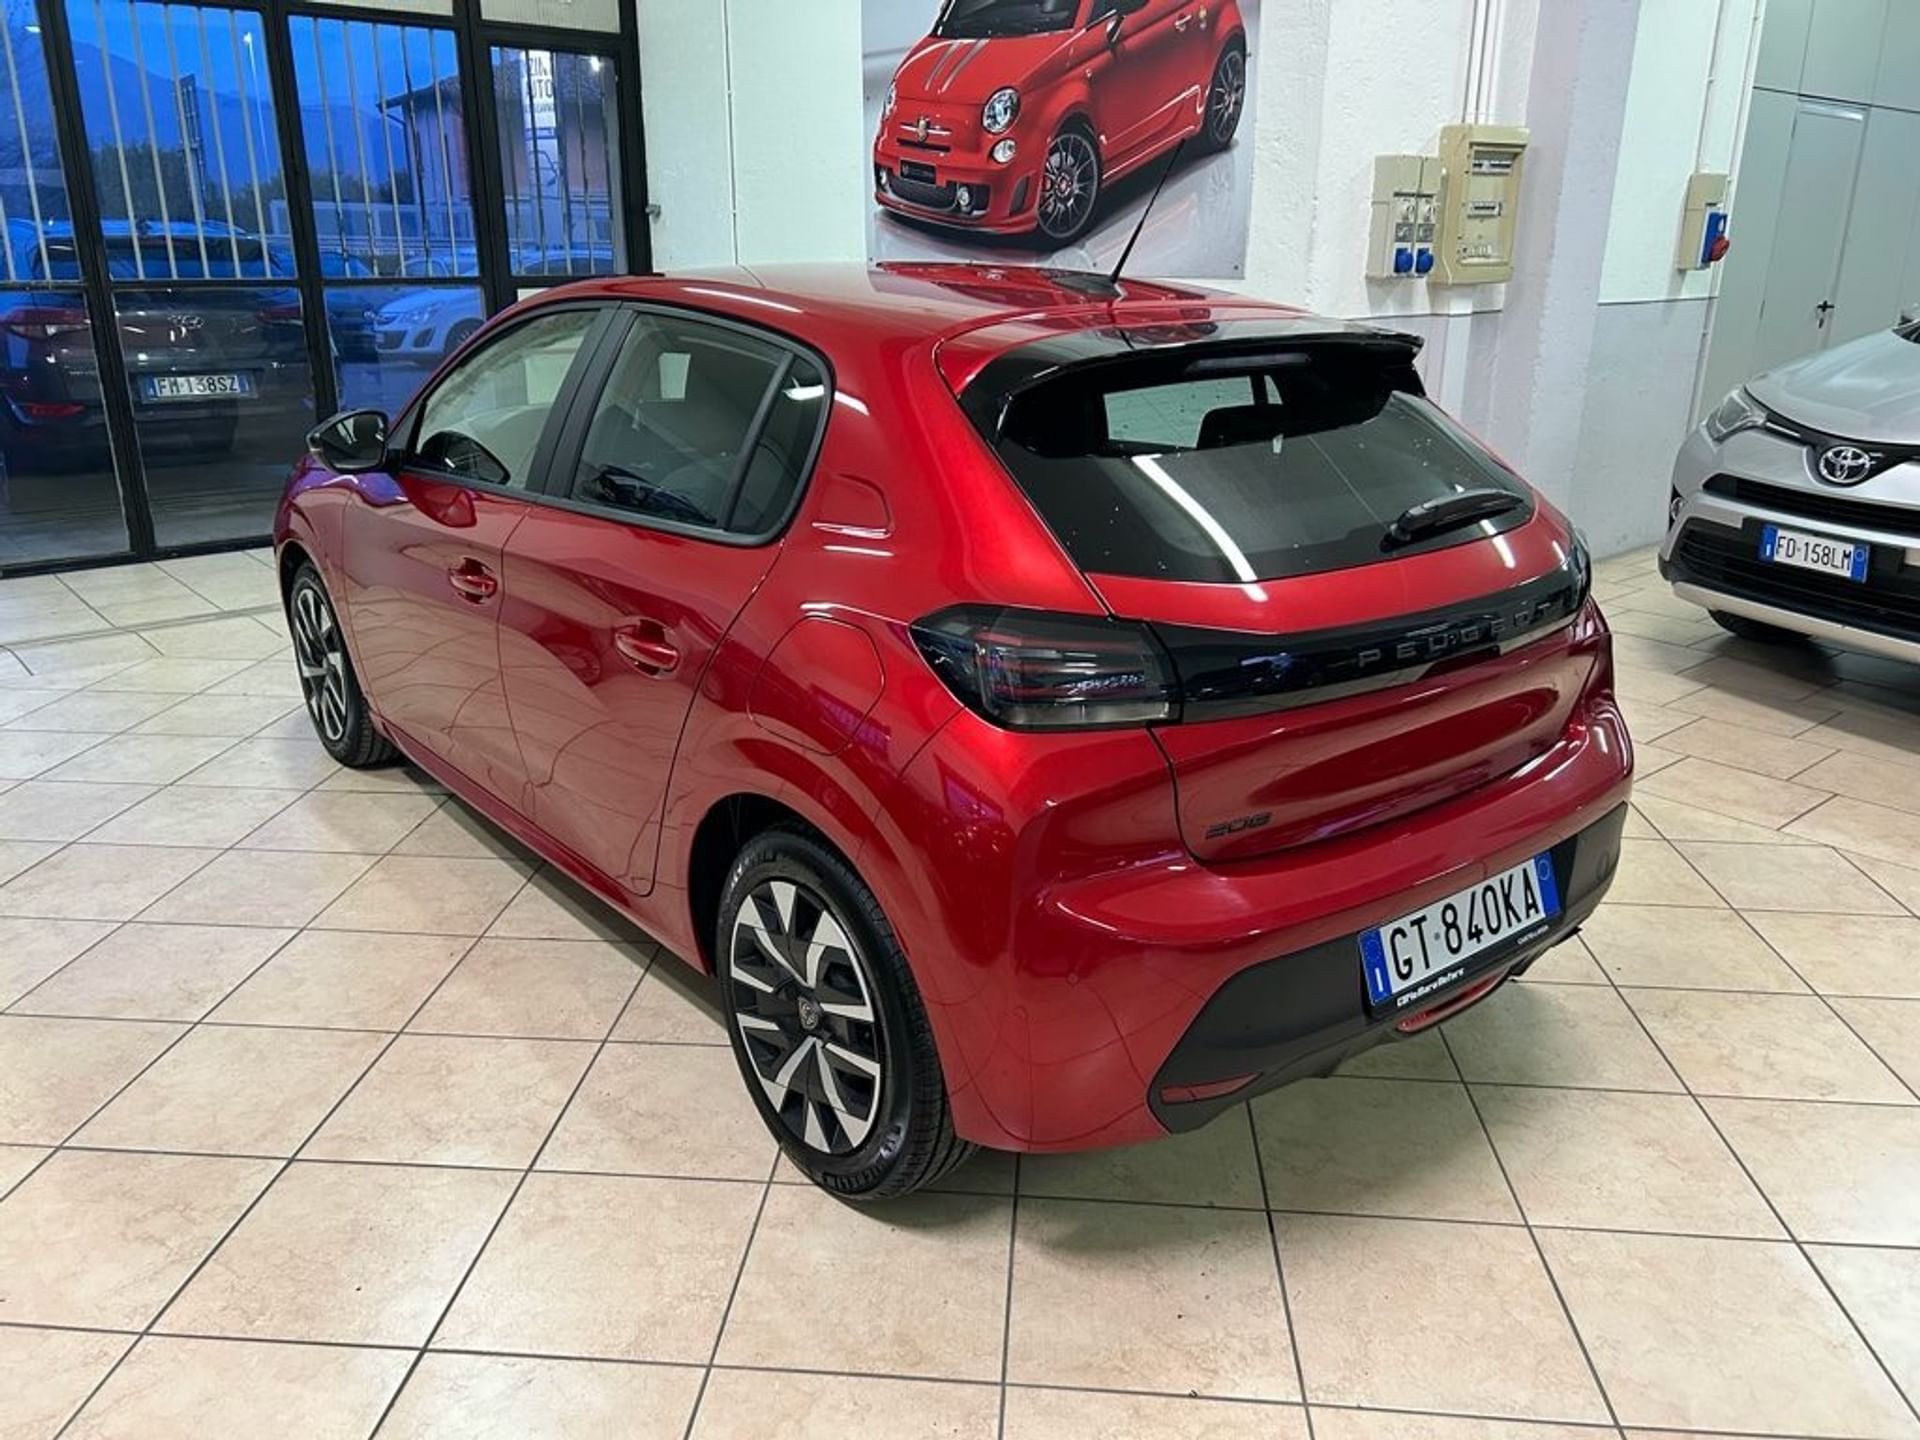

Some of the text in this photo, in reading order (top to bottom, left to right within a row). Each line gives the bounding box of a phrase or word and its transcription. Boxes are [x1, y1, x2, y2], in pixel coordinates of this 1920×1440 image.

[1803, 542, 1852, 571] 158LM
[1389, 914, 1430, 981] GT
[1441, 867, 1540, 955] 840KA
